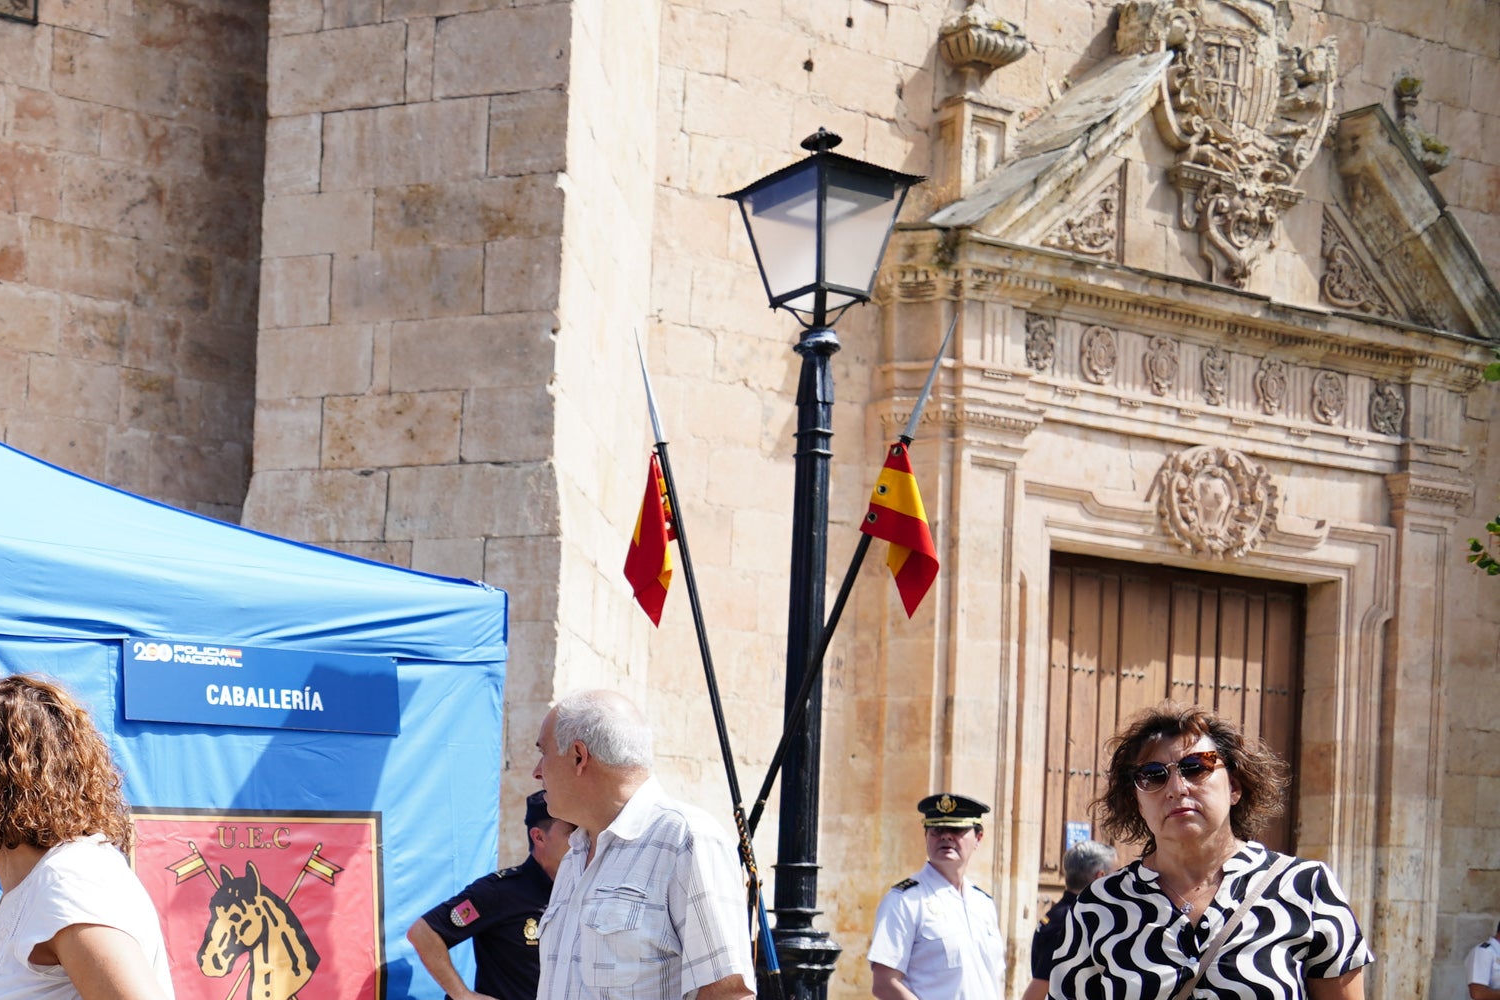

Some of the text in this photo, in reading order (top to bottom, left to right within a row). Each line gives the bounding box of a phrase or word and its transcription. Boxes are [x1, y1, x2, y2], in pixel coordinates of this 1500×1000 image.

[173, 644, 228, 658] POLICIA
[173, 653, 243, 667] NACIONAL
[206, 684, 324, 712] CABALLERÍA
[216, 826, 291, 849] U.E.C
